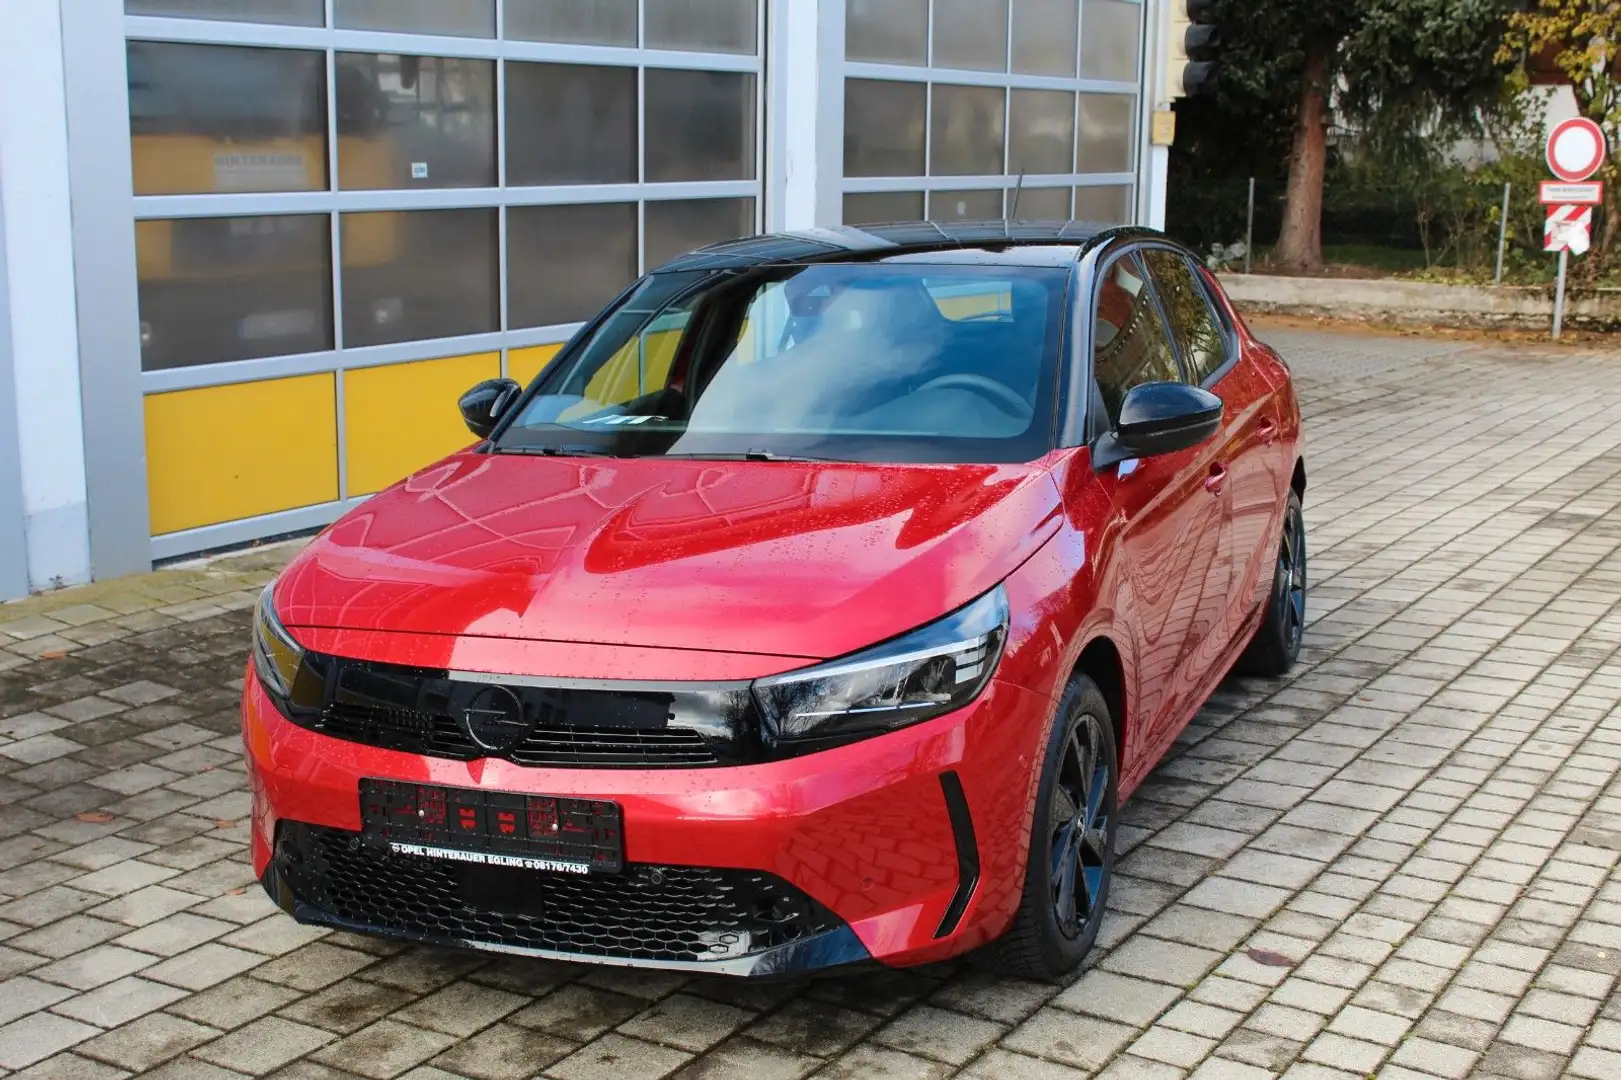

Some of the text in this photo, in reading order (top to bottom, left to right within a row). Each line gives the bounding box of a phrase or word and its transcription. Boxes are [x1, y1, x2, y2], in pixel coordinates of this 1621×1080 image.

[401, 844, 425, 857] OPEL
[426, 847, 486, 864] HINTERAUER
[487, 854, 524, 868] EGLING
